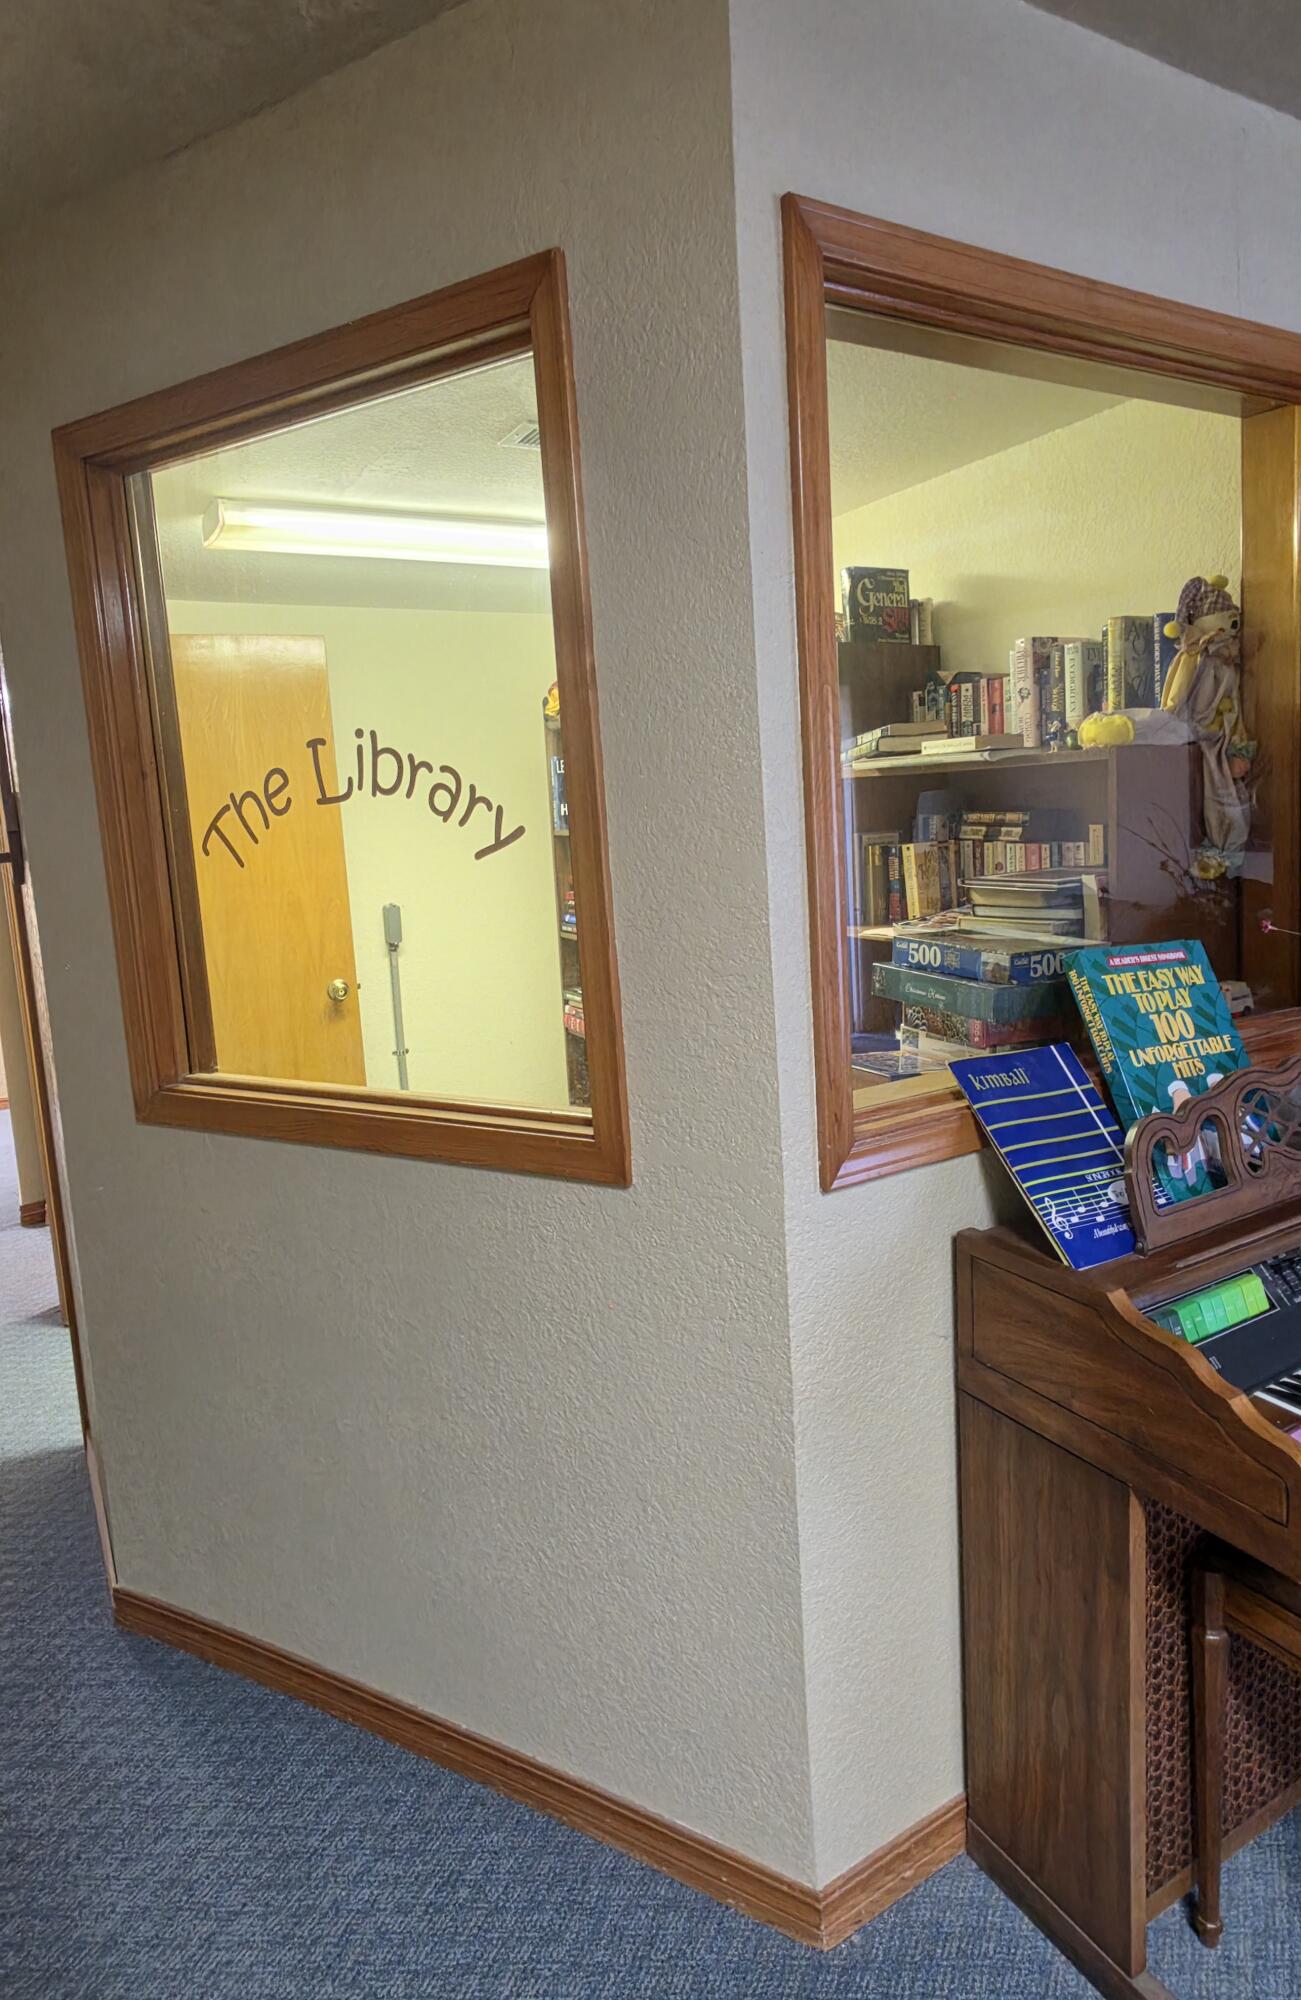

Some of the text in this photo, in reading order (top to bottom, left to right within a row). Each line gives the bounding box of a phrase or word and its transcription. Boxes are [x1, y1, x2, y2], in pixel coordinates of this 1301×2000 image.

[857, 578, 908, 613] General
[201, 728, 526, 869] The Library
[908, 942, 941, 967] 500
[1030, 953, 1065, 978] 500
[1068, 968, 1080, 985] 100
[1101, 964, 1205, 996] THE EASY WAY
[1131, 987, 1193, 1014] TO PLAY
[1149, 1009, 1196, 1044] 100
[1129, 1034, 1235, 1068] UNFORGETTABLE
[1172, 1058, 1206, 1079] HITS
